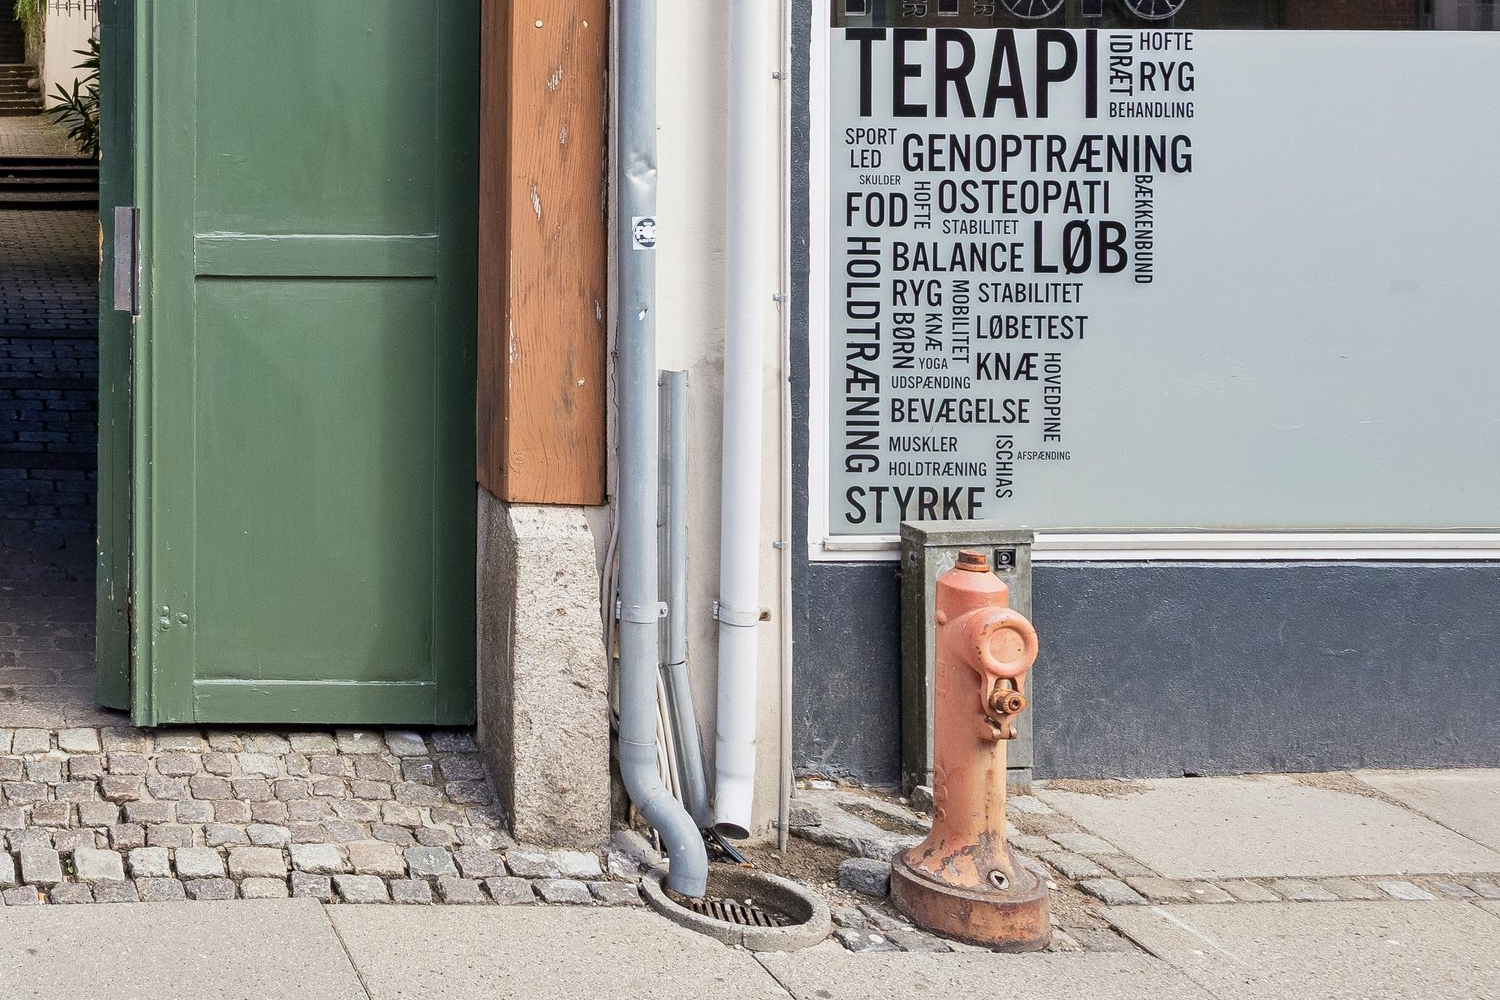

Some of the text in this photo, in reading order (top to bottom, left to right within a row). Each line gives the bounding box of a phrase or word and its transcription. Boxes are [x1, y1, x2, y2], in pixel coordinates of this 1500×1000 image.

[1139, 31, 1194, 51] HOFTE
[844, 28, 1098, 119] TERAPI
[1109, 34, 1134, 97] IDRÆT
[1139, 61, 1195, 92] RYG
[1108, 101, 1195, 119] BEHANDLING
[844, 127, 898, 146] SPORT
[850, 149, 882, 169] LED
[902, 132, 1193, 174] GENOPTRÆNING
[858, 174, 902, 186] SKULDER
[846, 191, 909, 228] FOD
[913, 180, 932, 230] HOFTE
[937, 178, 1110, 215] OSTEOPATI
[941, 219, 1020, 235] STABILITET
[1134, 174, 1154, 285] BÆKKENBUND
[892, 241, 1025, 273] BALANCE
[1033, 218, 1129, 275] LØB
[892, 278, 943, 307] RYG
[977, 281, 1084, 304] STABILITET
[924, 312, 943, 352] KNÆ
[951, 279, 970, 364] MOBILITET
[975, 313, 1089, 341] LØBETEST
[845, 236, 881, 474] HOLDTRÆNING
[891, 312, 916, 369] BØRN
[918, 356, 949, 370] YOGA
[975, 351, 1039, 381] KNÆ
[890, 375, 972, 390] UDSPÆNDING
[1043, 352, 1062, 443] HOVEDPINE
[890, 397, 1031, 424] BEVÆGELSE
[888, 435, 959, 453] MUSKLER
[1016, 450, 1071, 461] AFSPÆNDING
[888, 461, 988, 477] HOLDTRÆNING
[995, 434, 1014, 499] ISCHIAS
[844, 485, 986, 525] STYRKE
